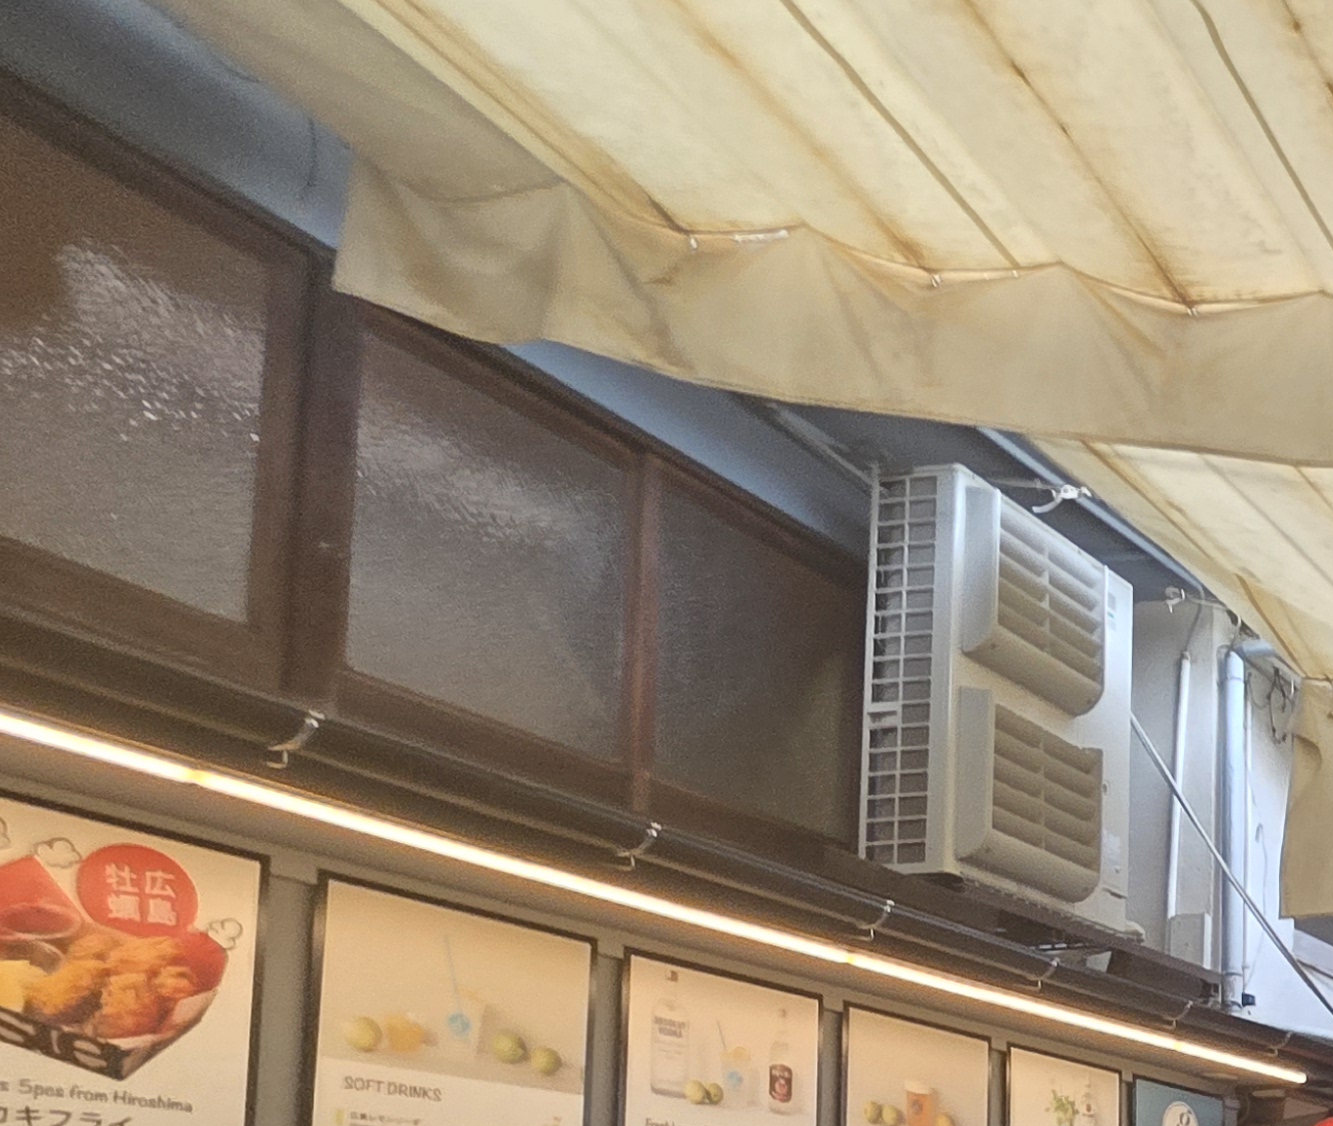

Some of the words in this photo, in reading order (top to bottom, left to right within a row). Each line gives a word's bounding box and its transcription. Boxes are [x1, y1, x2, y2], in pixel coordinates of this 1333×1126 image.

[145, 869, 178, 927] 広島
[69, 1086, 108, 1102] from
[113, 1091, 193, 1113] Hiroshima
[344, 1076, 384, 1093] SOFT
[387, 1082, 442, 1101] DRINKS
